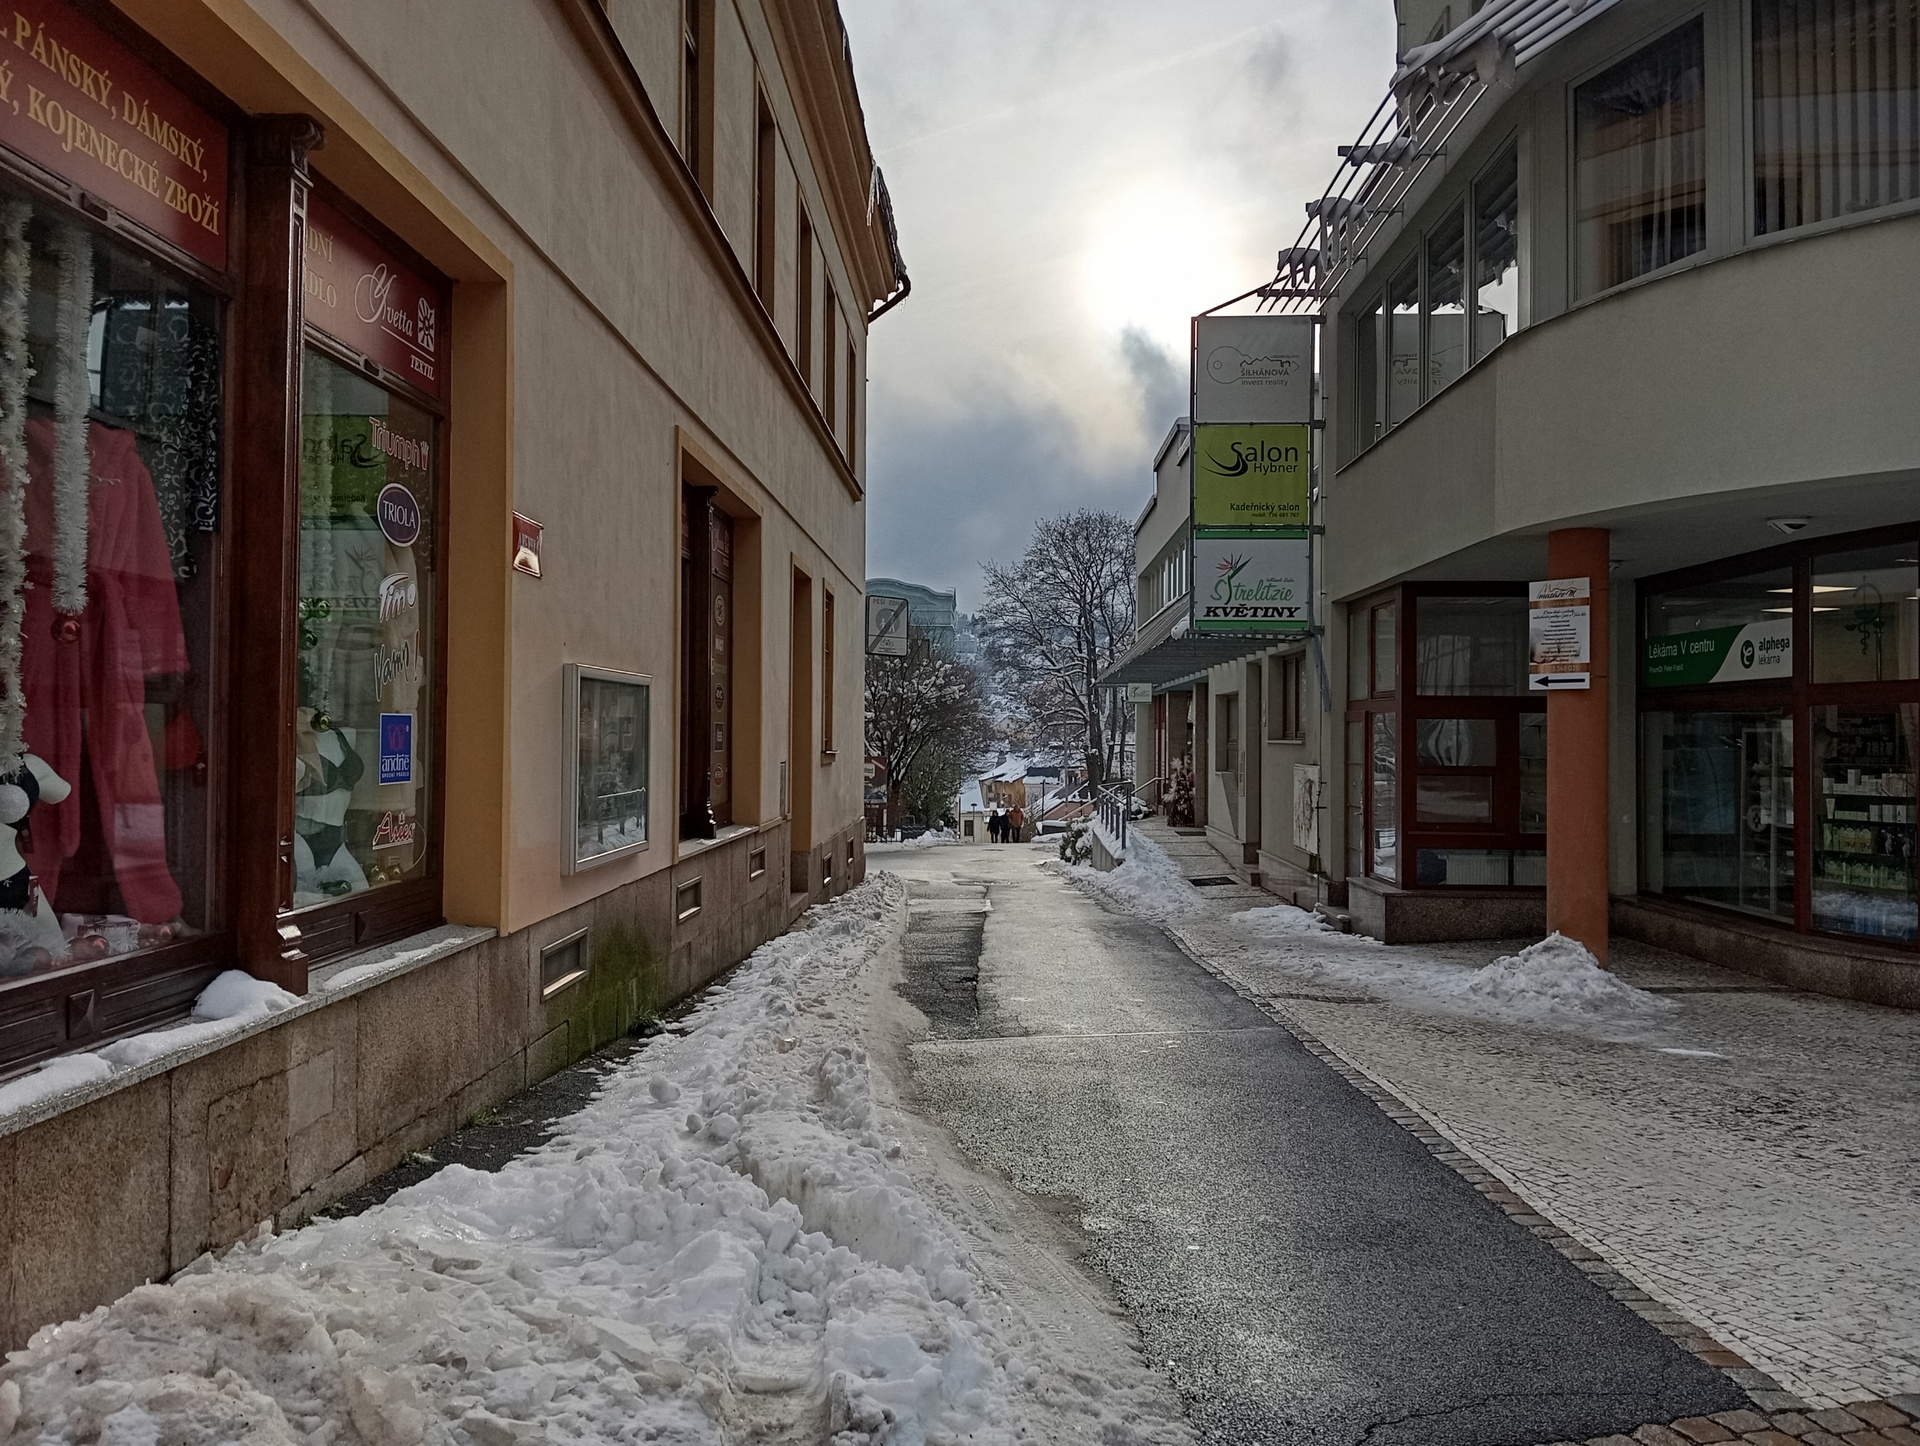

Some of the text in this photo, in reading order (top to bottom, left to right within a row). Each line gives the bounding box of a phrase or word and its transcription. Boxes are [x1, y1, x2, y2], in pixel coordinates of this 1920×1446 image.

[14, 11, 208, 183] PÁNSKÝ, DÁMSKÝ,
[27, 83, 160, 198] KOJENECKÉ
[163, 175, 220, 236] ZBOŽÍ
[306, 270, 337, 308] DLO
[410, 354, 434, 381] TEXTIL
[1241, 367, 1289, 376] ŠILHÁNOVÁ
[368, 416, 420, 470] Triumph
[1253, 462, 1298, 475] Hybner
[383, 500, 416, 529] TRIOLA
[1277, 502, 1300, 511] salon
[1210, 578, 1294, 604] Strelitzie
[1203, 603, 1301, 618] KVĚTINY
[1649, 639, 1715, 659] Lékárna V centru
[1758, 636, 1790, 653] alphega
[1758, 653, 1781, 665] lékárna
